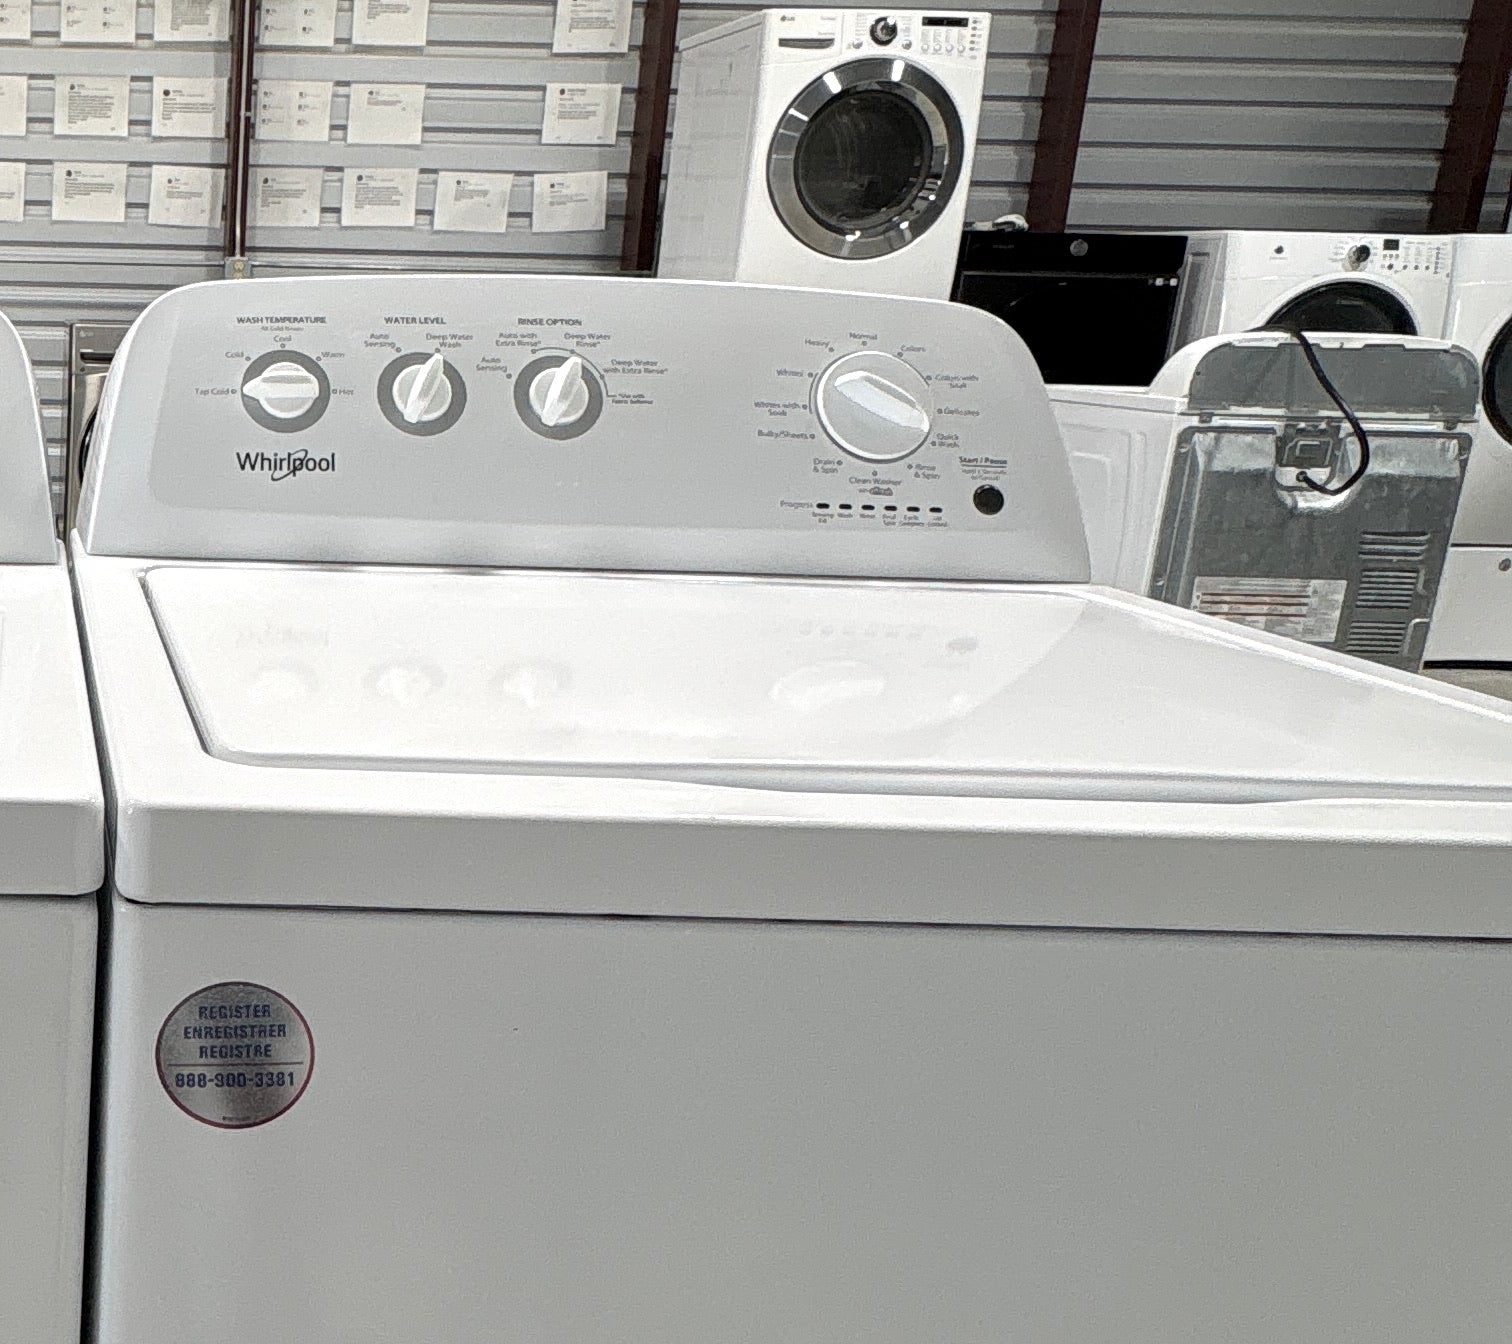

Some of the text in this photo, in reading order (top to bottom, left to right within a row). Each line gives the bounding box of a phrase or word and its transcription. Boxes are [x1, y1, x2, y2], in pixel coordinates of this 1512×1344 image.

[518, 318, 582, 326] RINSE OPTION
[564, 333, 586, 341] Deep
[476, 364, 508, 372] Sensing
[236, 452, 336, 477] Whirlpool
[198, 1004, 271, 1019] REGISTER
[184, 1024, 287, 1040] ENREGISTRER
[199, 1044, 272, 1059] REGISTRE
[175, 1072, 295, 1089] 888-900-3381
